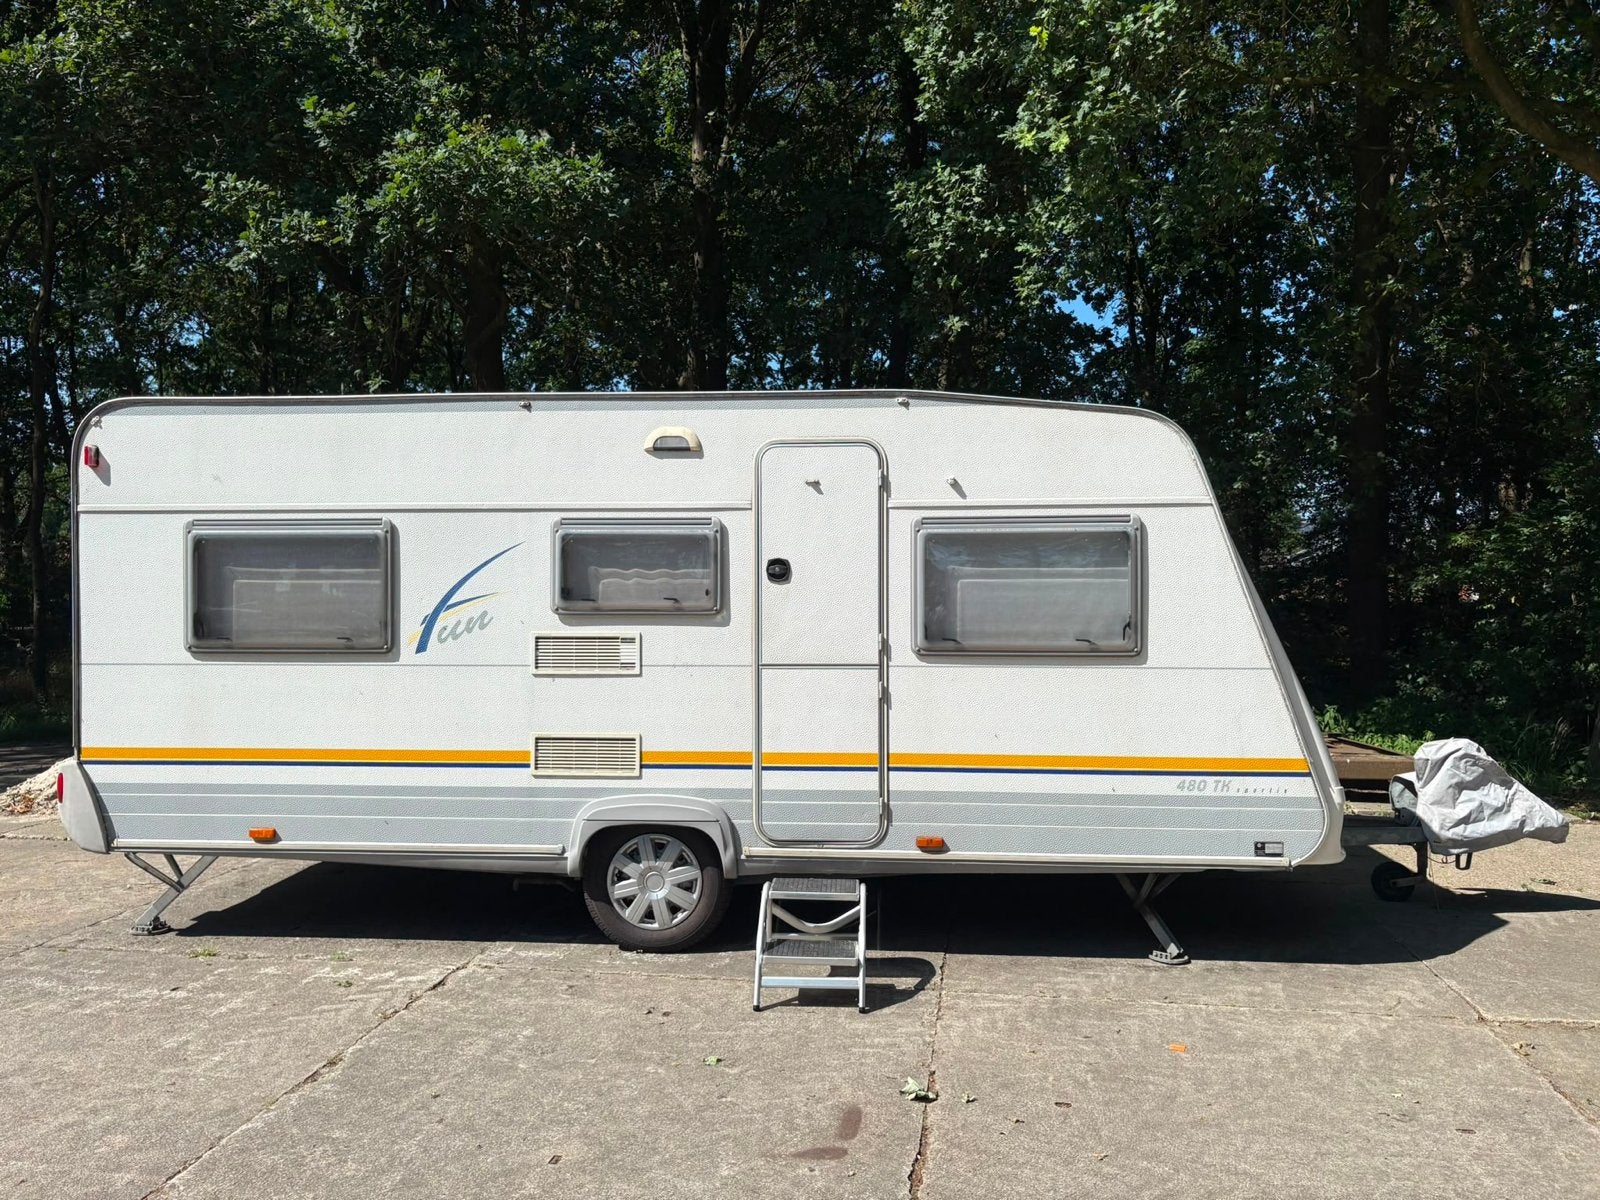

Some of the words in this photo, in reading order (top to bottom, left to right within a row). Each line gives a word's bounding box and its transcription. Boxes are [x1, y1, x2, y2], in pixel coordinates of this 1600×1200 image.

[414, 540, 525, 655] Fun
[1176, 779, 1207, 792] 480
[1213, 779, 1232, 793] TK
